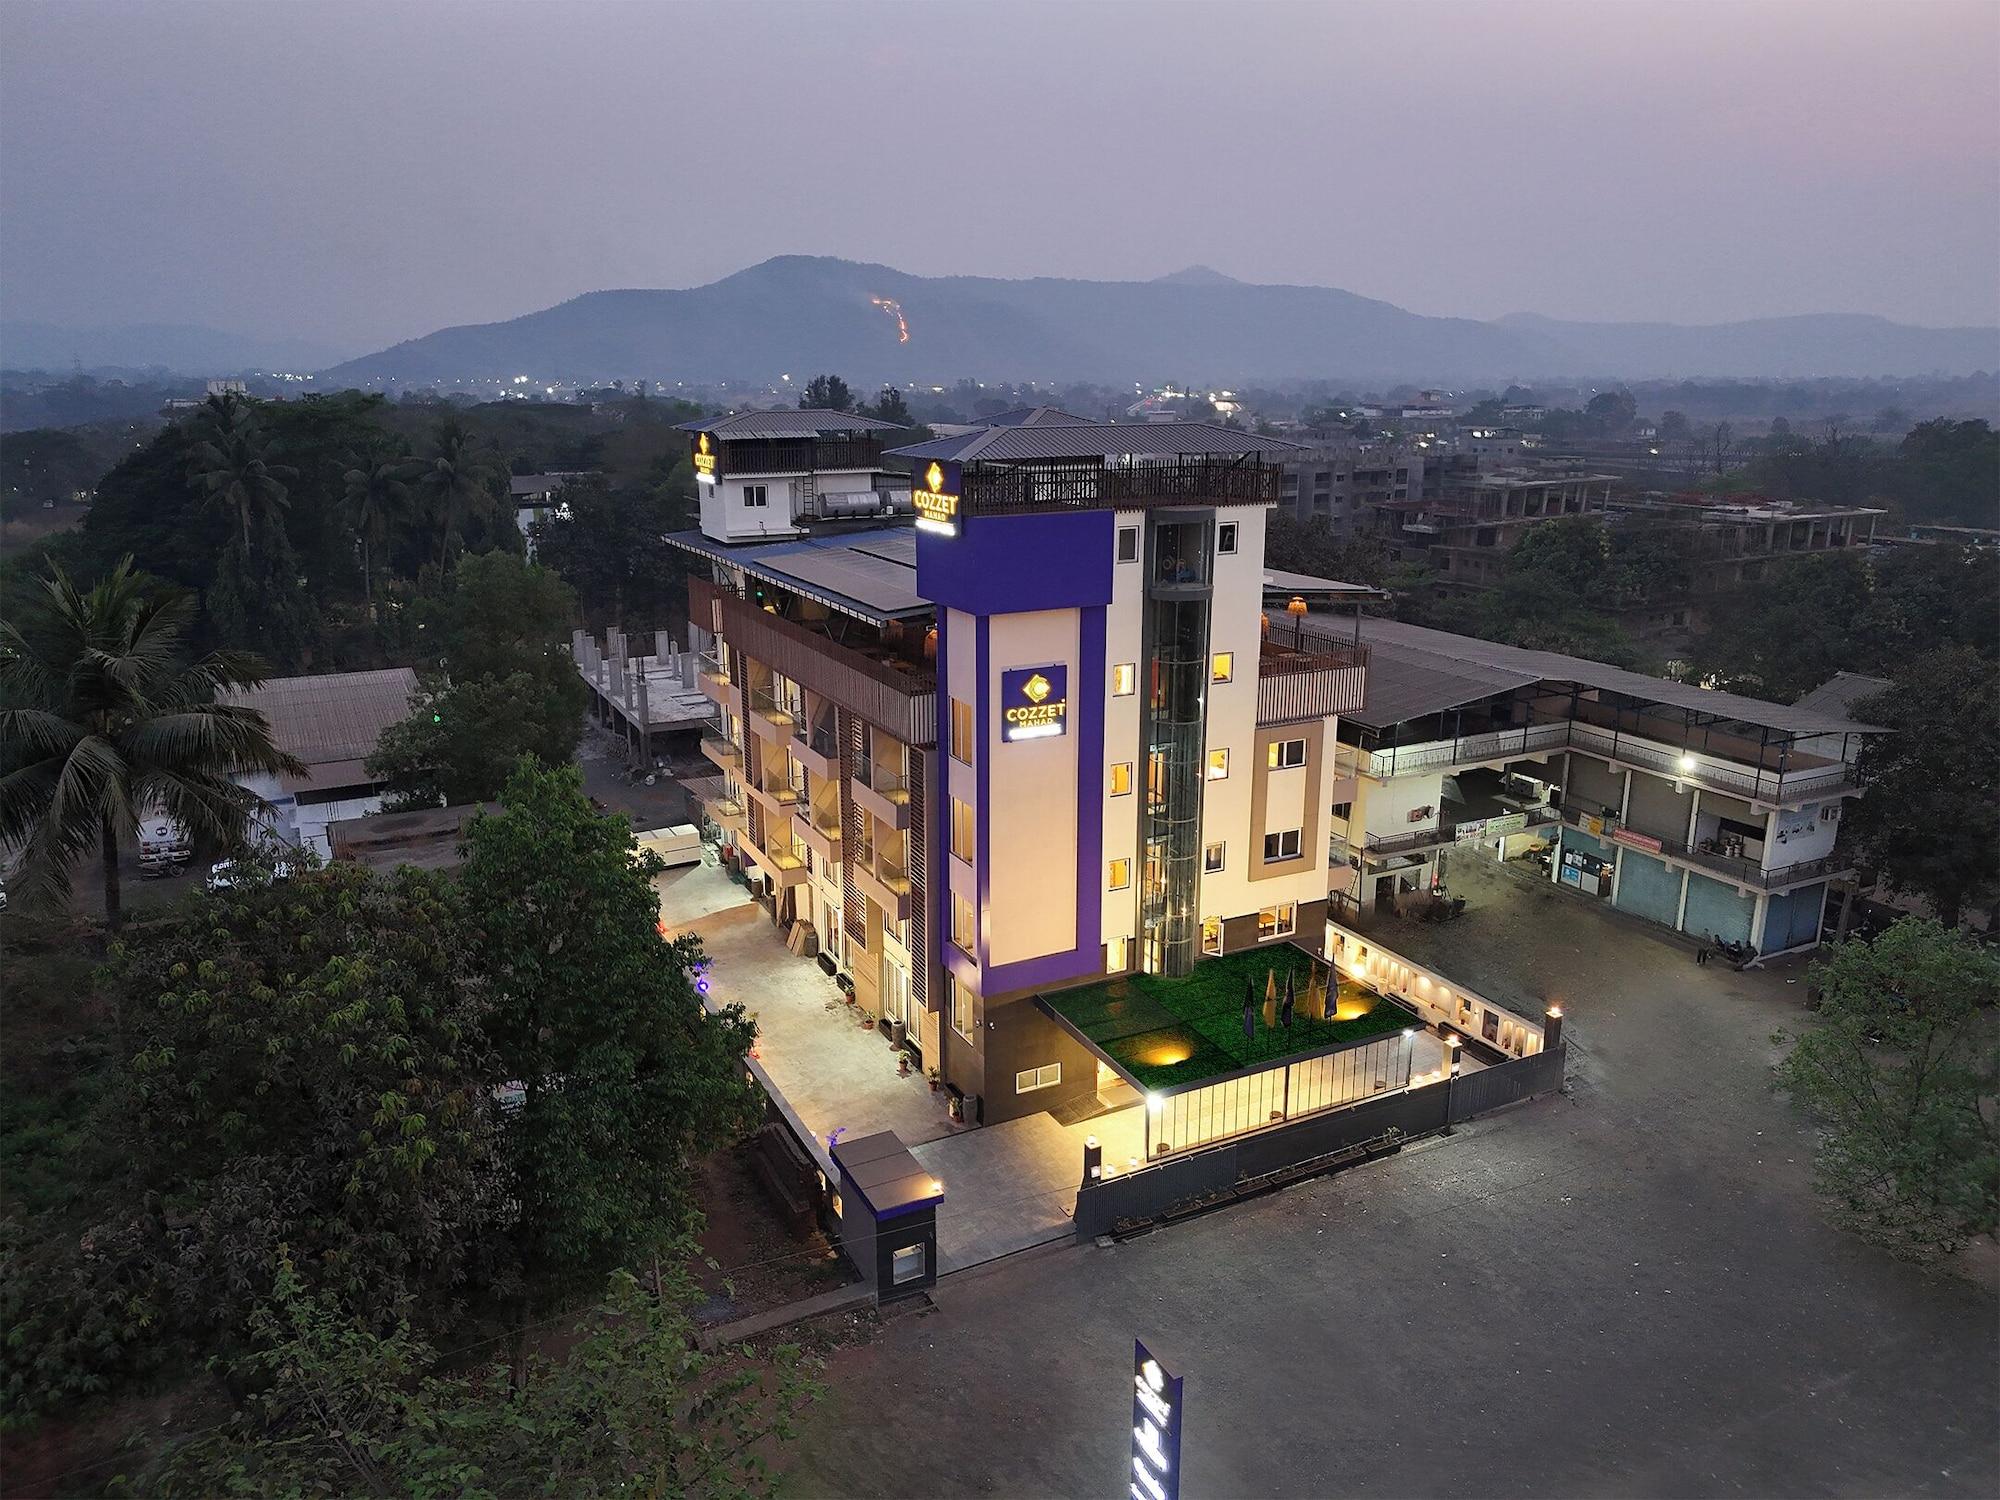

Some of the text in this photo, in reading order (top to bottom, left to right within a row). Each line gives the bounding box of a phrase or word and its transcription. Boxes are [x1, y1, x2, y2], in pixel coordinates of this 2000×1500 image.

[914, 490, 957, 514] COZZET
[1007, 704, 1065, 722] COZZET
[1019, 718, 1053, 728] MAHAD
